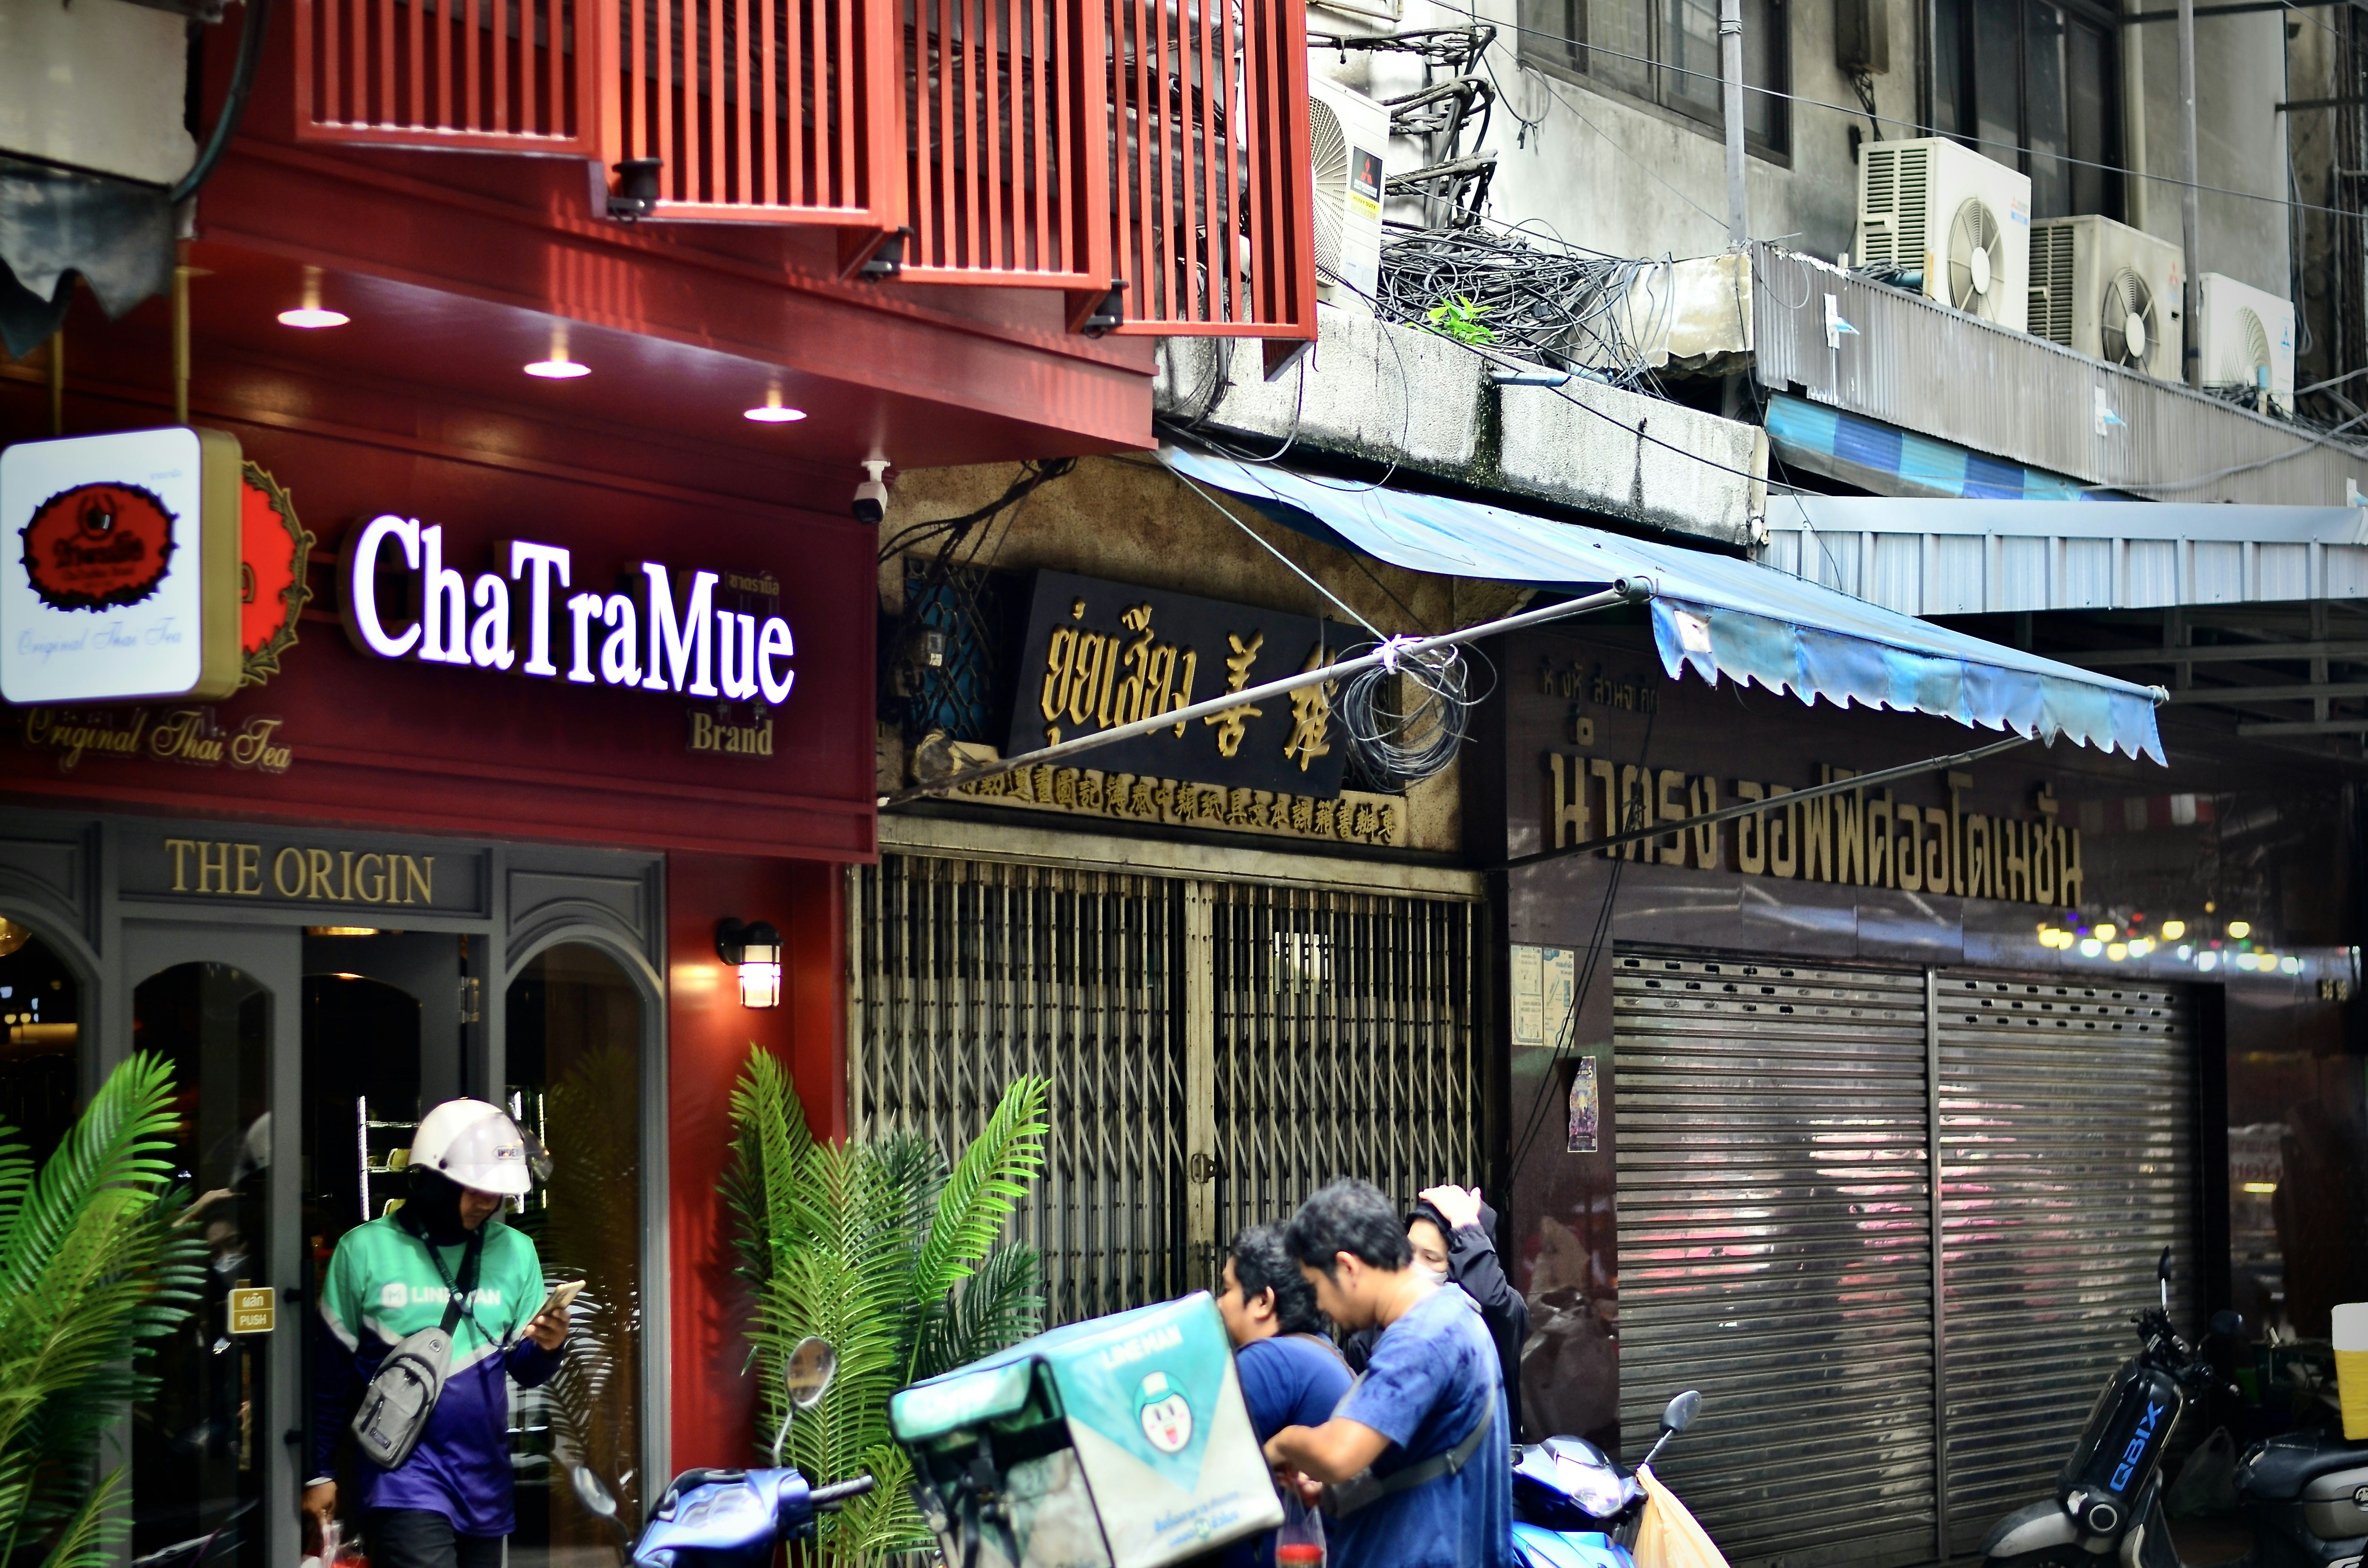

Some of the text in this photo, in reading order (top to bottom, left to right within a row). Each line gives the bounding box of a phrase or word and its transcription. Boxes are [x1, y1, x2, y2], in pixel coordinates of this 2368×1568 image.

[353, 514, 795, 704] ChaTraMue
[25, 708, 291, 769] Original Thai Tea
[691, 711, 774, 756] Brand
[164, 838, 435, 905] THE ORIGIN
[239, 1314, 267, 1326] PUSH
[2109, 1400, 2164, 1492] QBIX
